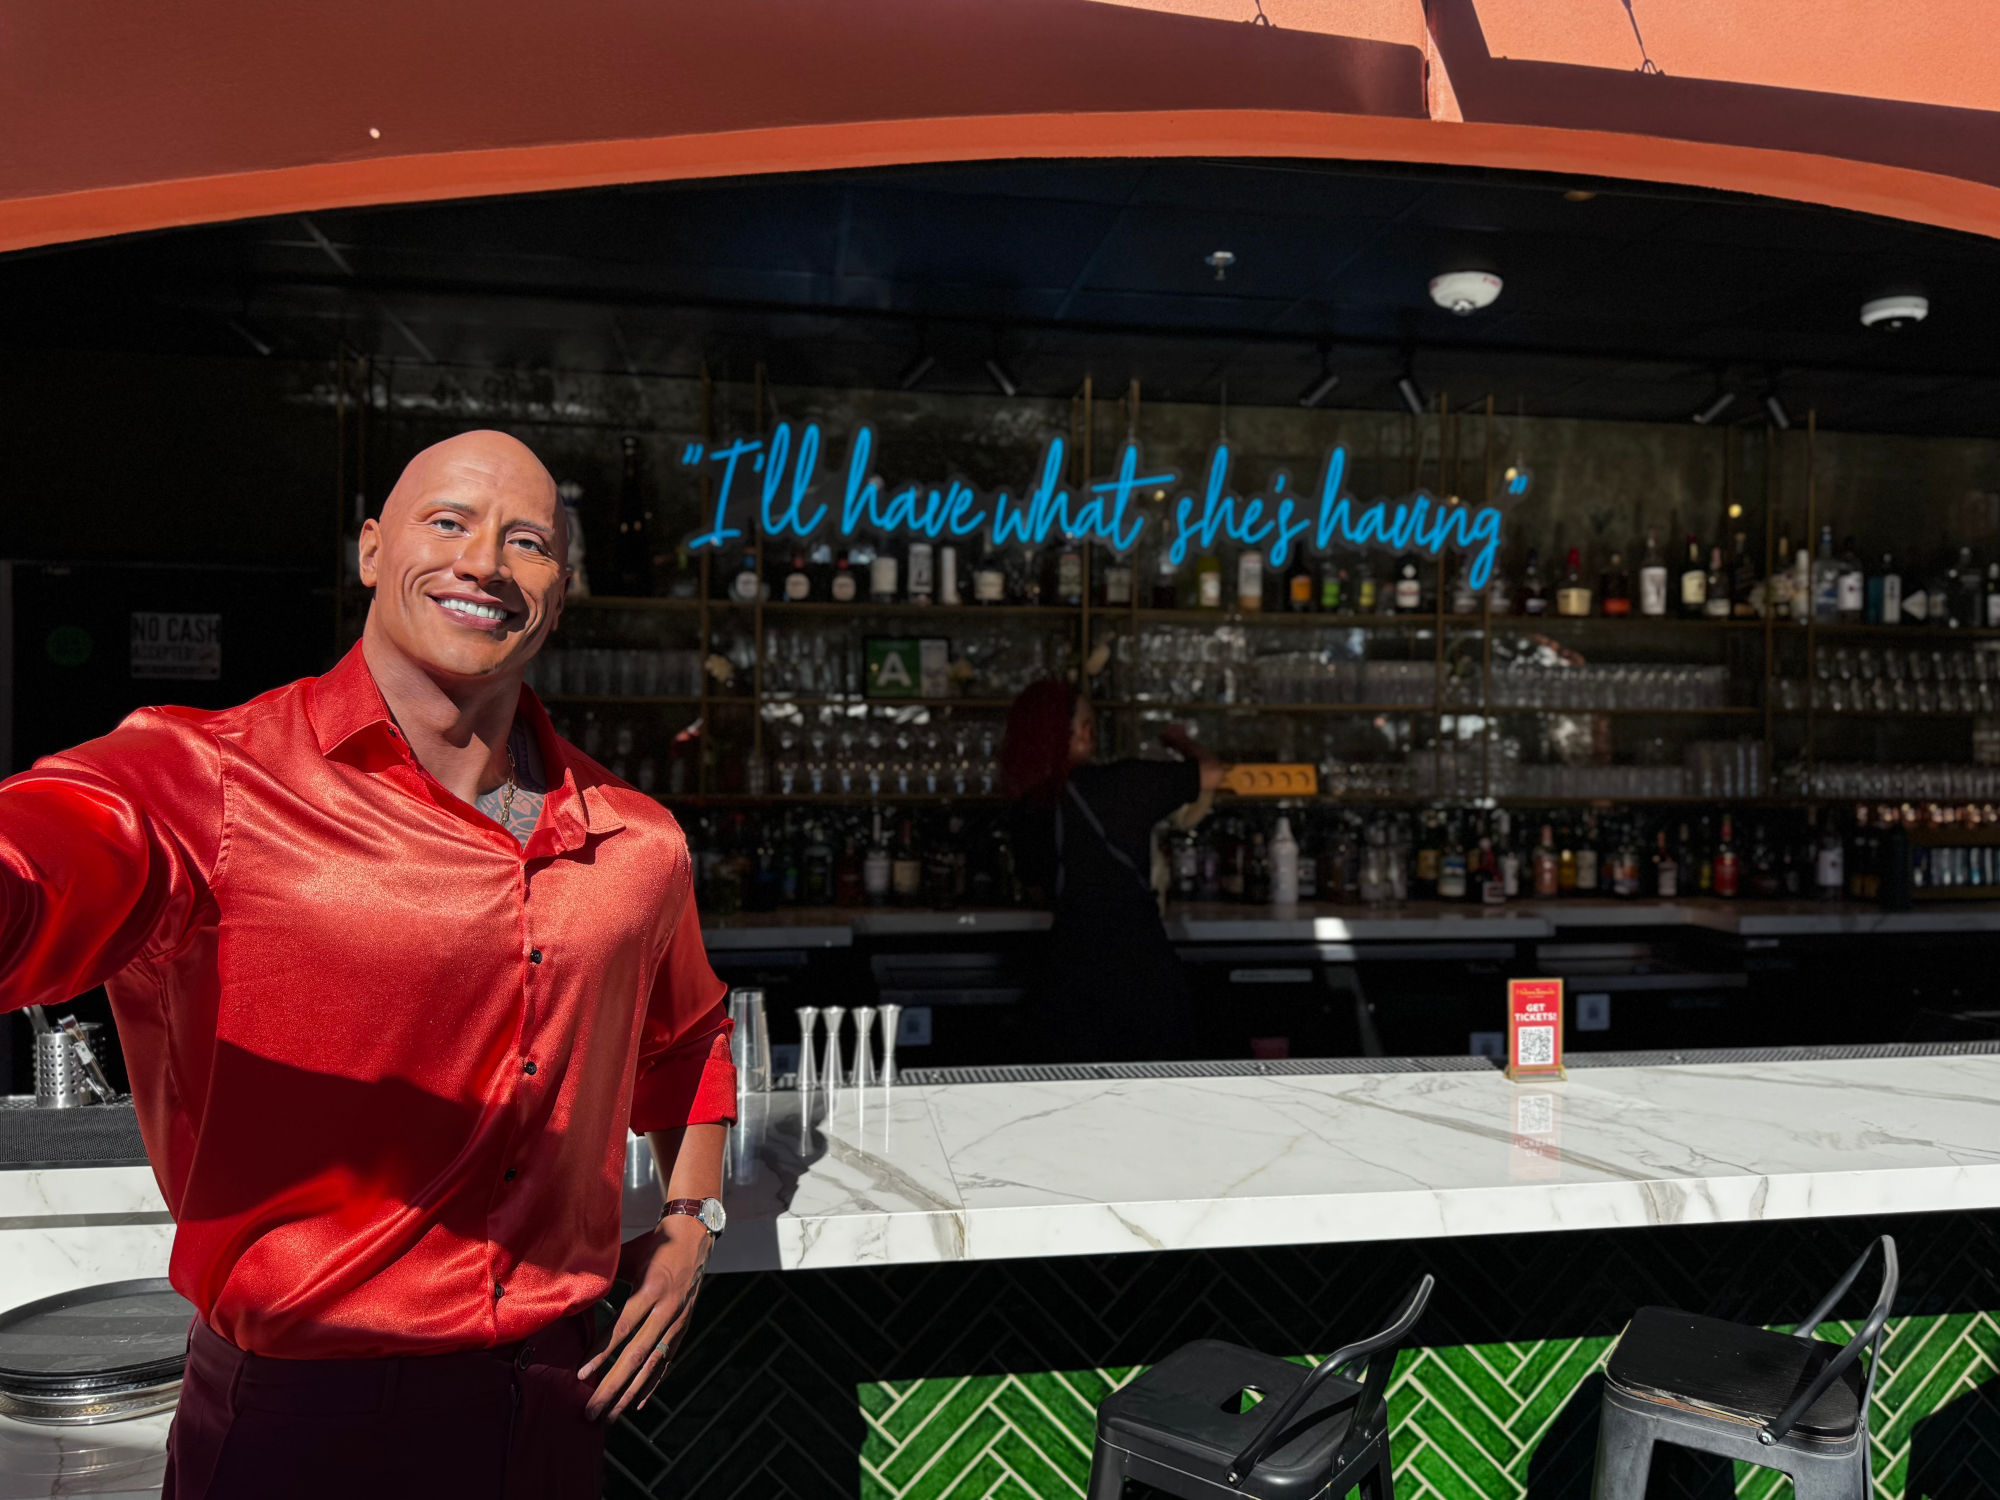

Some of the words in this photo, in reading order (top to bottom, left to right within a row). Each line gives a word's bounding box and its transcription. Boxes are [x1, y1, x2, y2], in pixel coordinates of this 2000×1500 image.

[683, 423, 827, 548] "I'll
[842, 427, 985, 537] have
[993, 438, 1175, 551] what
[1169, 446, 1309, 566] she's
[1317, 447, 1529, 590] having"
[131, 616, 159, 642] NO
[167, 617, 221, 643] CASH
[877, 651, 912, 688] A
[1514, 1012, 1557, 1022] TICKETS!
[1526, 1003, 1546, 1013] GET
